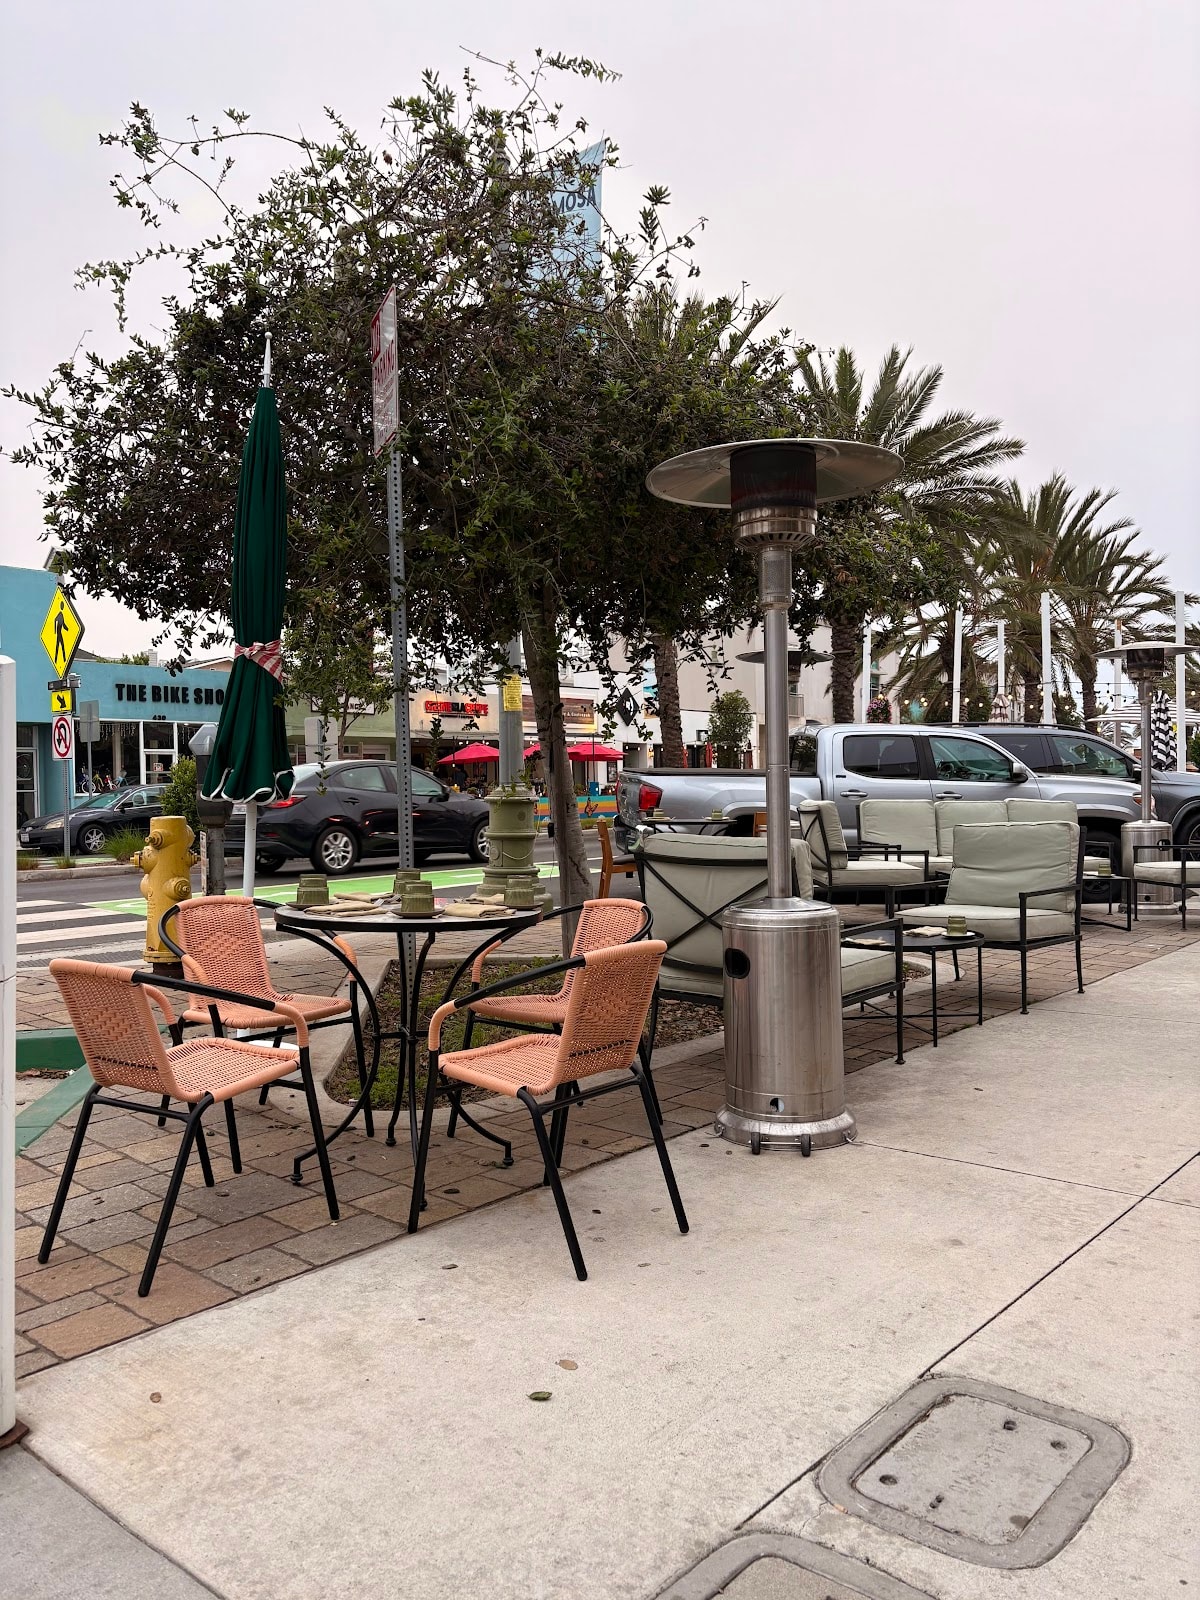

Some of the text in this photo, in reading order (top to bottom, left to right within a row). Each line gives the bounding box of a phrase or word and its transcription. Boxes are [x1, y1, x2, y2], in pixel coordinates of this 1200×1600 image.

[553, 185, 597, 214] MOSA
[115, 684, 224, 705] THE BIKE SHO
